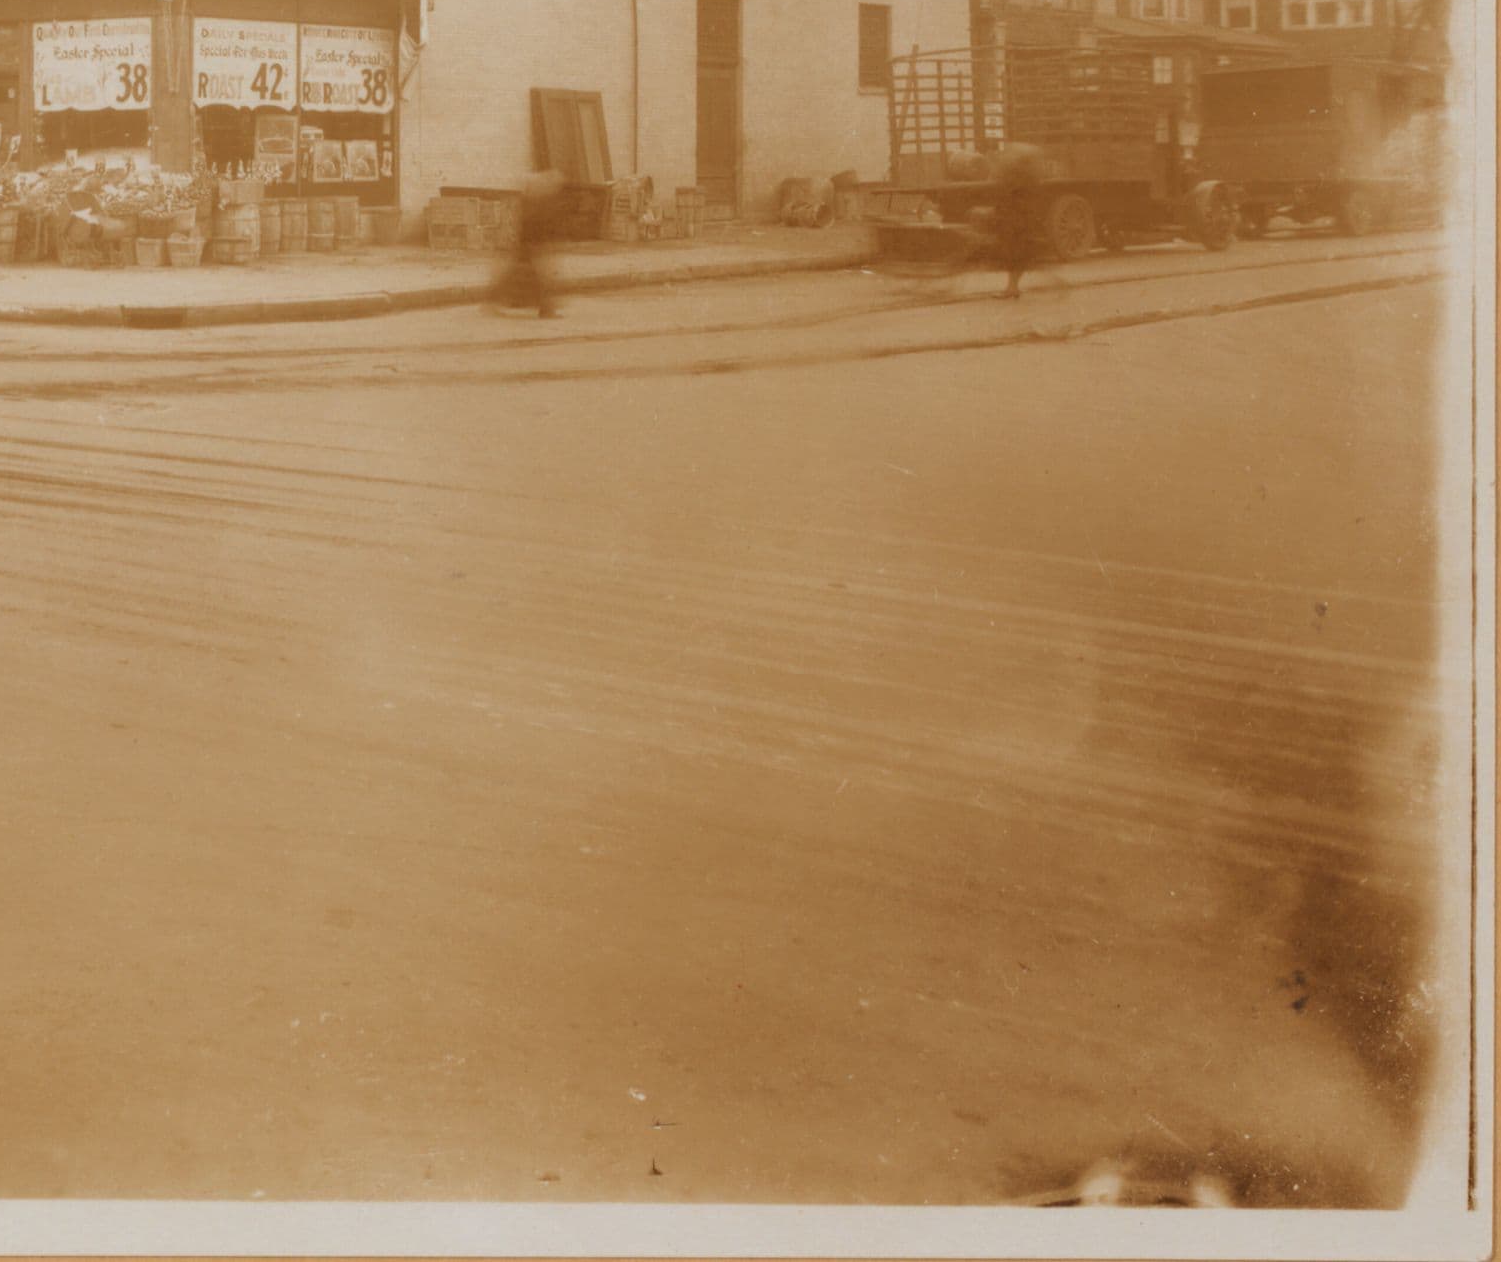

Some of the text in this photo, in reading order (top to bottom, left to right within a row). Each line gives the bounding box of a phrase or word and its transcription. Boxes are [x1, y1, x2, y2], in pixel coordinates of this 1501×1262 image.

[115, 62, 149, 104] 38
[198, 71, 246, 99] ROAST
[358, 68, 388, 107] 38
